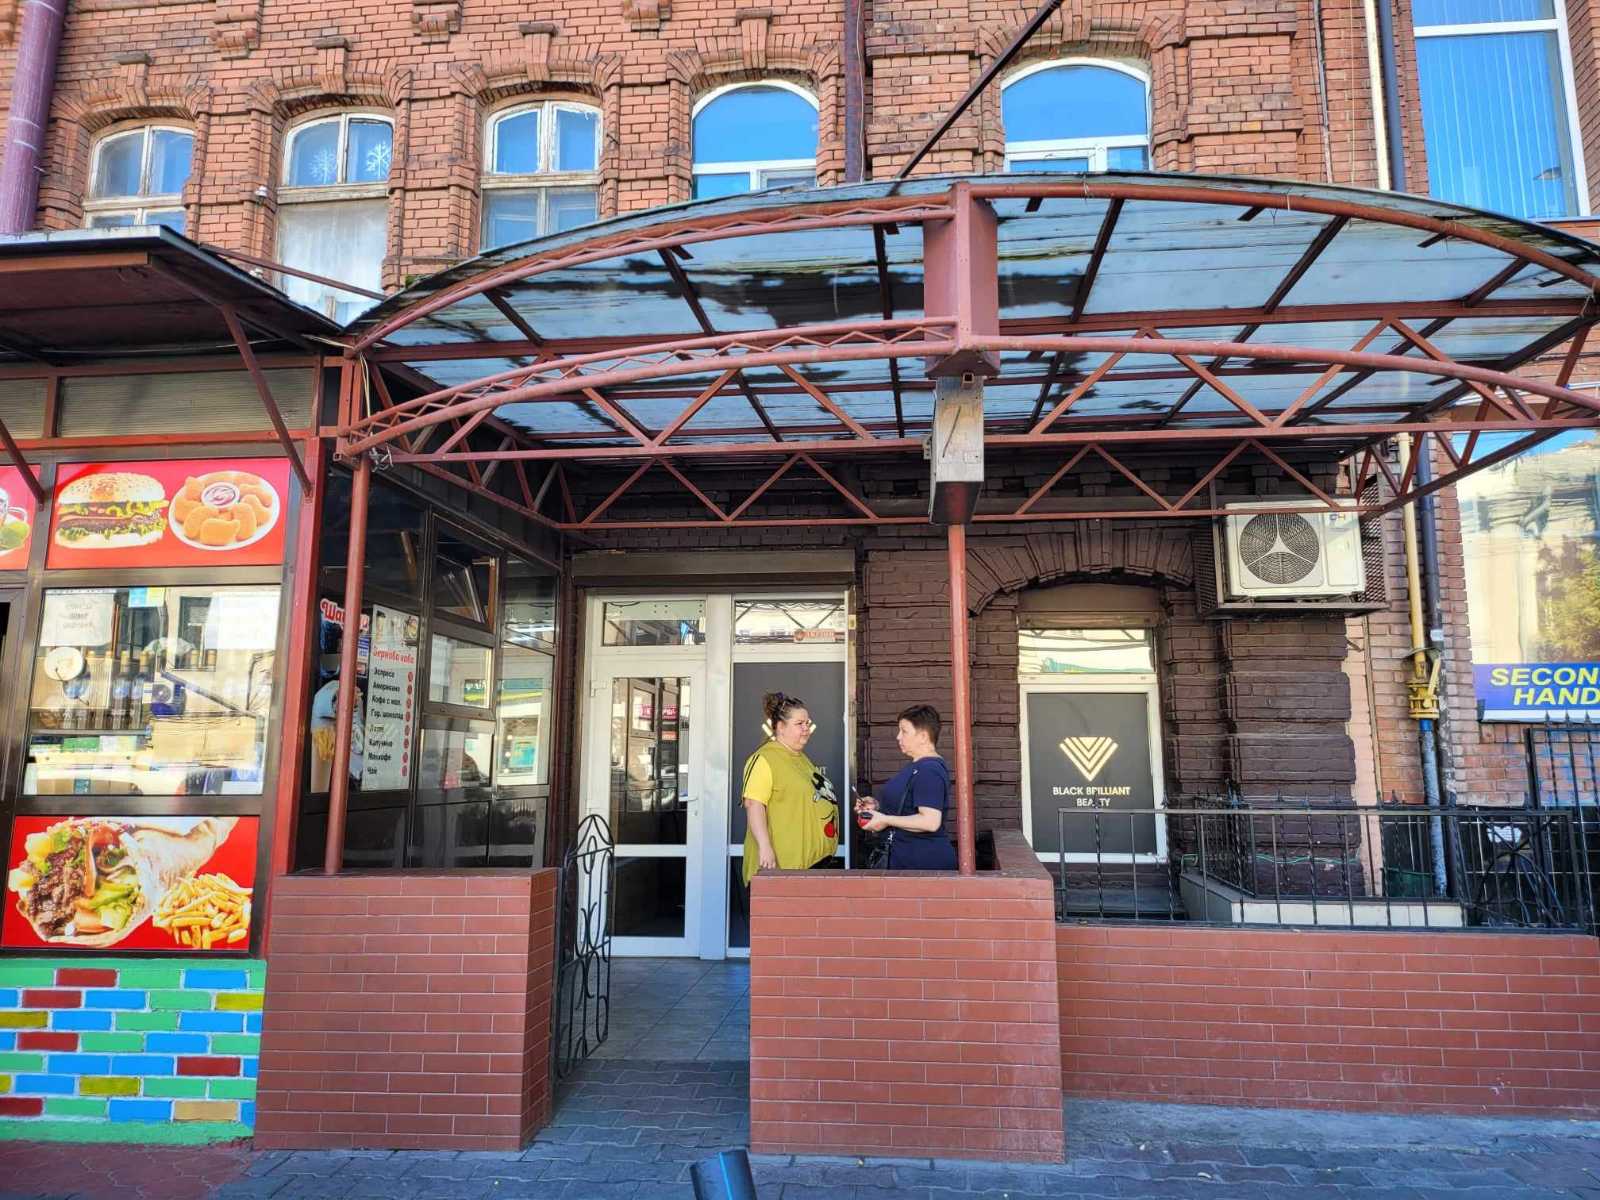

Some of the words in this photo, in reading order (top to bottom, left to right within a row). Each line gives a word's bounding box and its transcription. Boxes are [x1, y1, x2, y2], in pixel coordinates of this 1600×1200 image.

[1490, 667, 1600, 687] SECON
[1513, 687, 1600, 705] HAND
[1052, 786, 1084, 795] BLACK
[1076, 798, 1111, 807] BEATY
